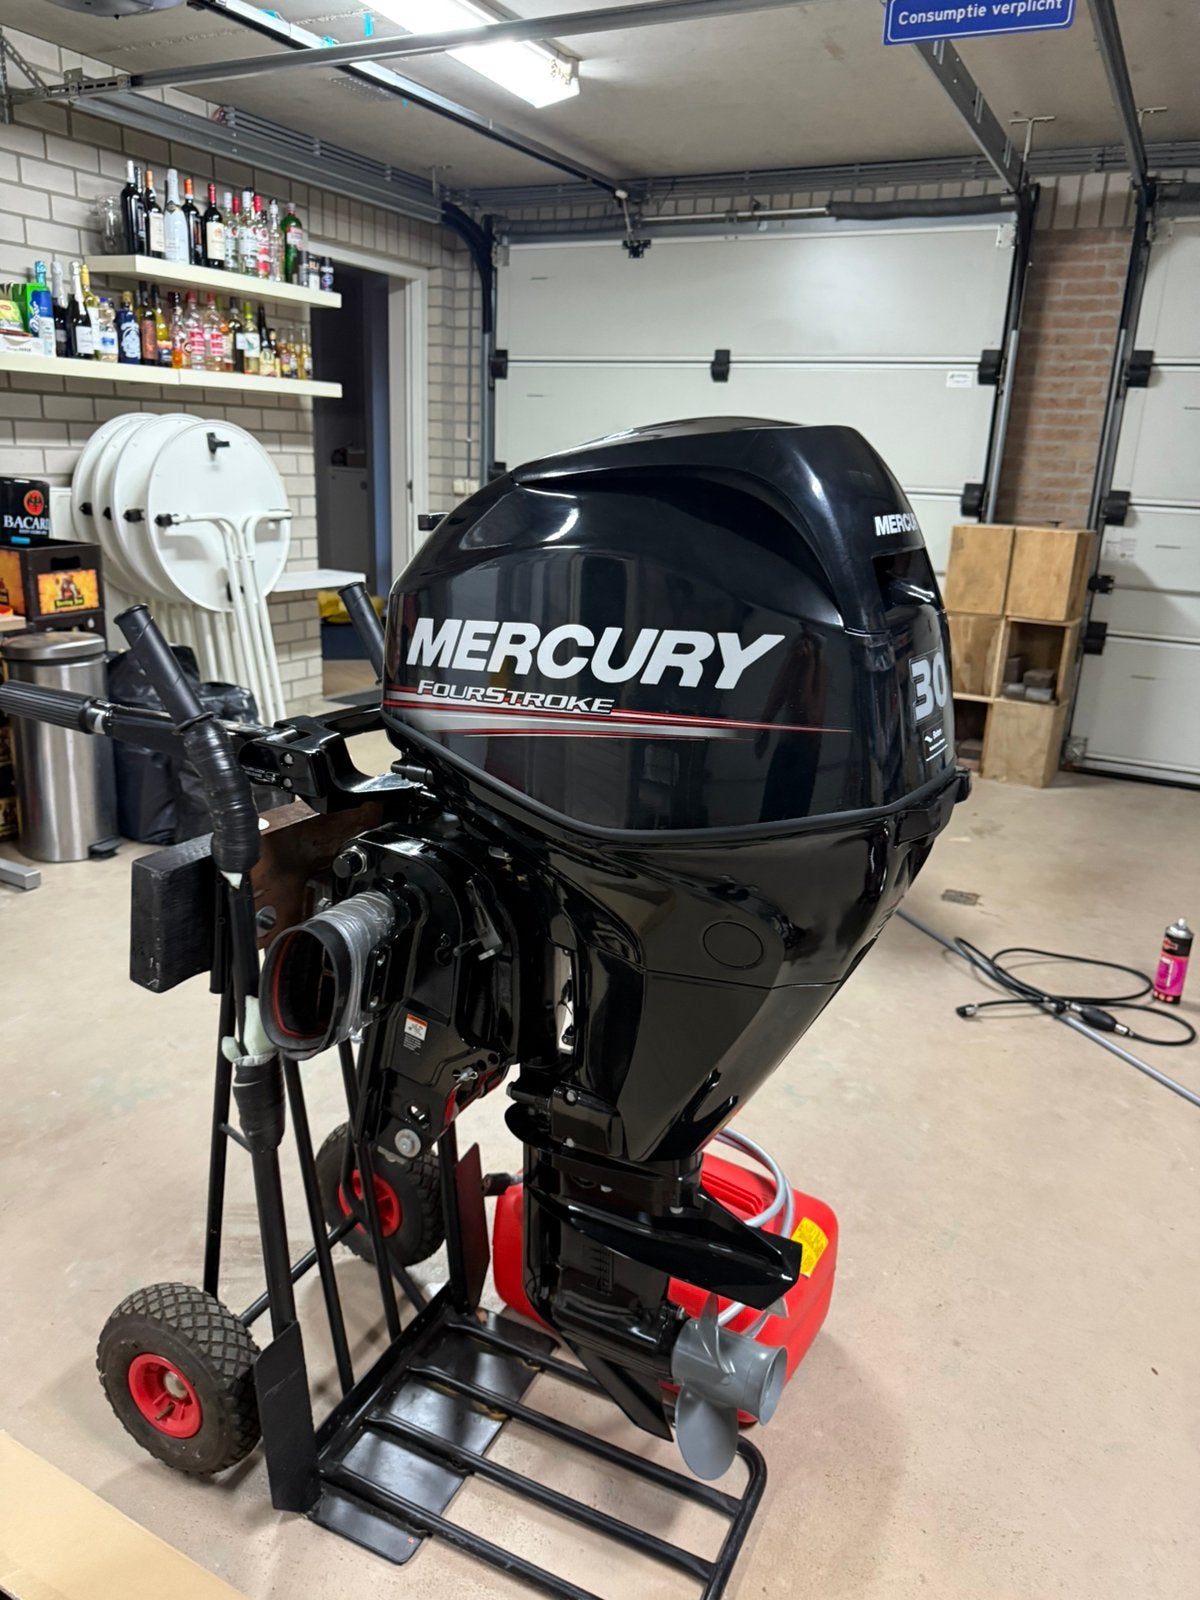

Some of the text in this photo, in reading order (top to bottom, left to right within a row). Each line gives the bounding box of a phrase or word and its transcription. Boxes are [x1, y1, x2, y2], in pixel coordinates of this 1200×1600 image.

[898, 0, 1063, 26] Consumptie verplicht
[874, 512, 918, 537] MERCU
[405, 617, 786, 690] MERCURY
[416, 679, 616, 714] FOURSTROKE
[911, 652, 948, 722] 30
